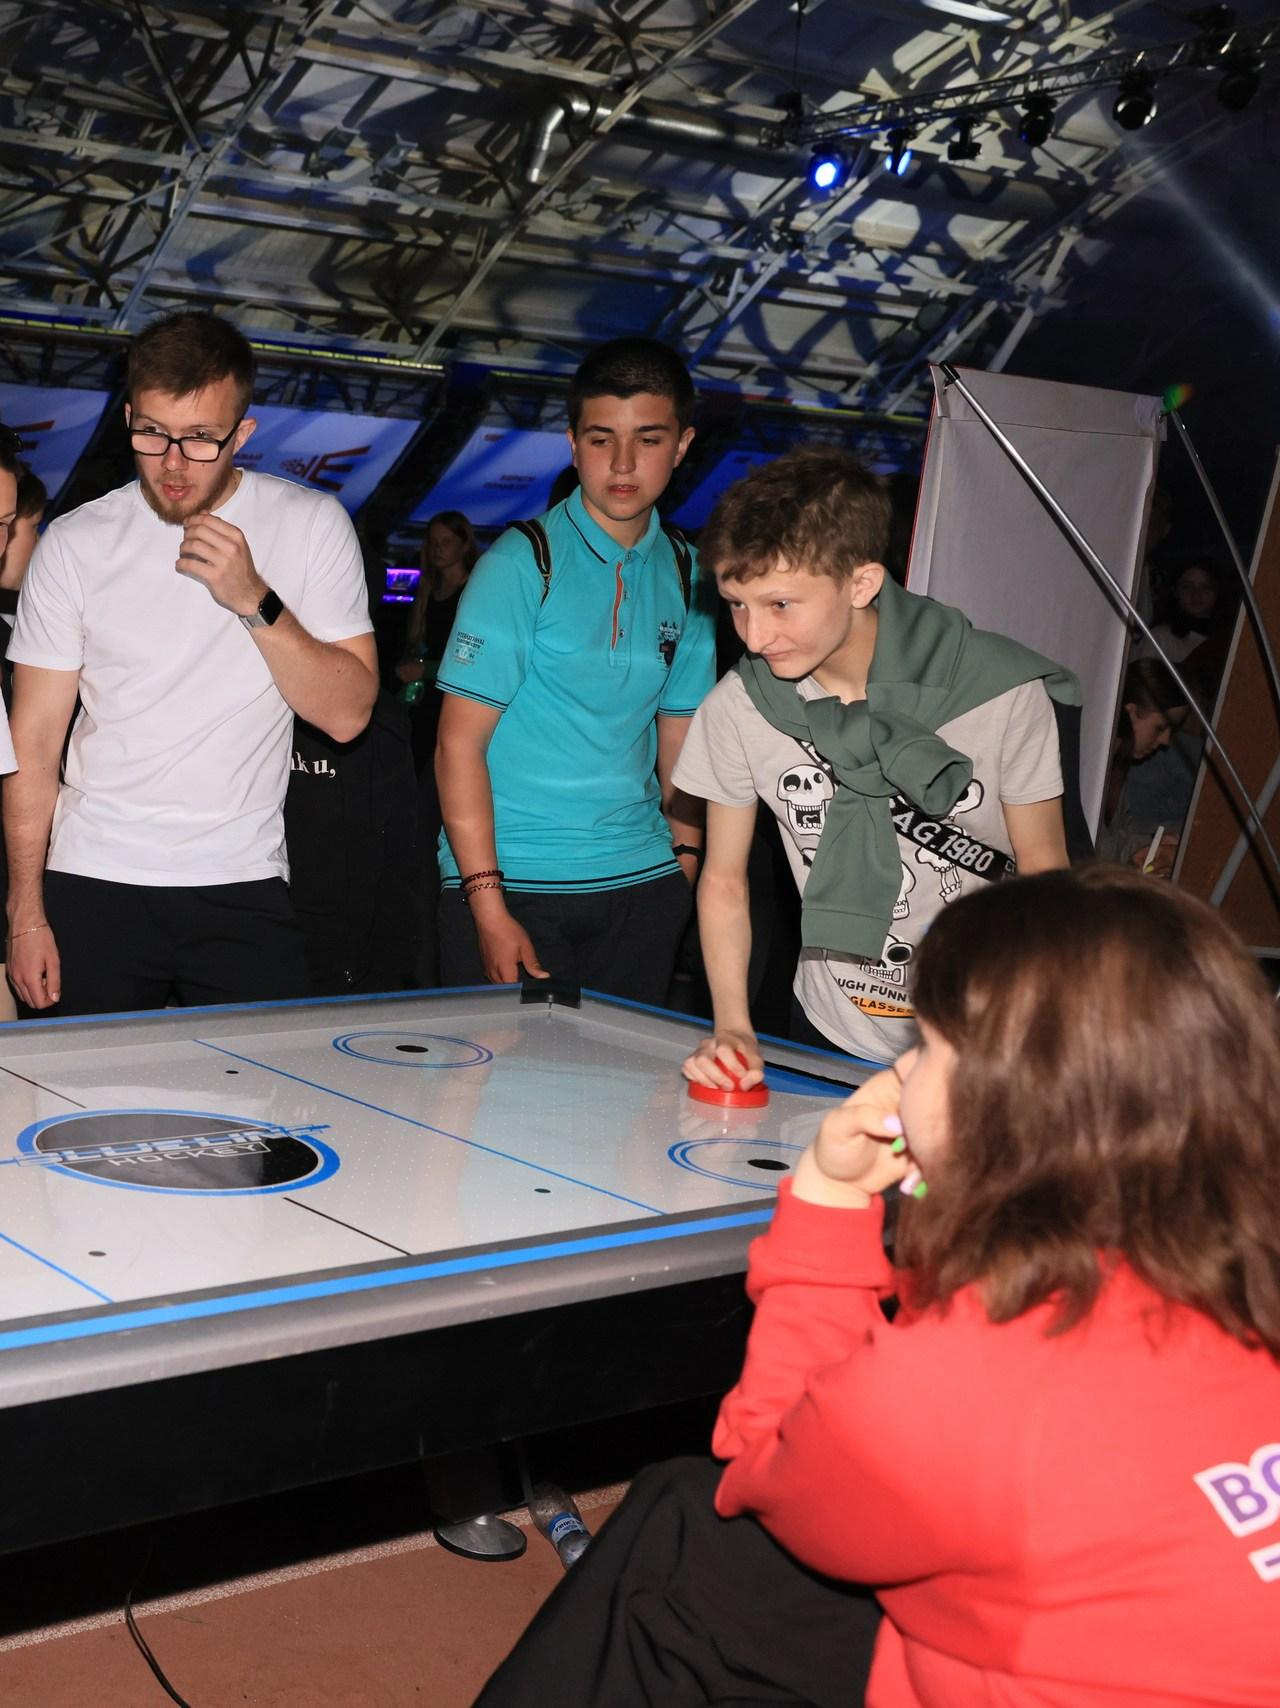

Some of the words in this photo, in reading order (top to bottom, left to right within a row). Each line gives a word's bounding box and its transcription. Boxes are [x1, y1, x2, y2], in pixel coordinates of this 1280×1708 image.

[889, 796, 995, 872] AG.1980
[834, 977, 866, 992] UGH
[869, 984, 913, 1003] FUNN
[108, 1143, 258, 1167] HOCKEY
